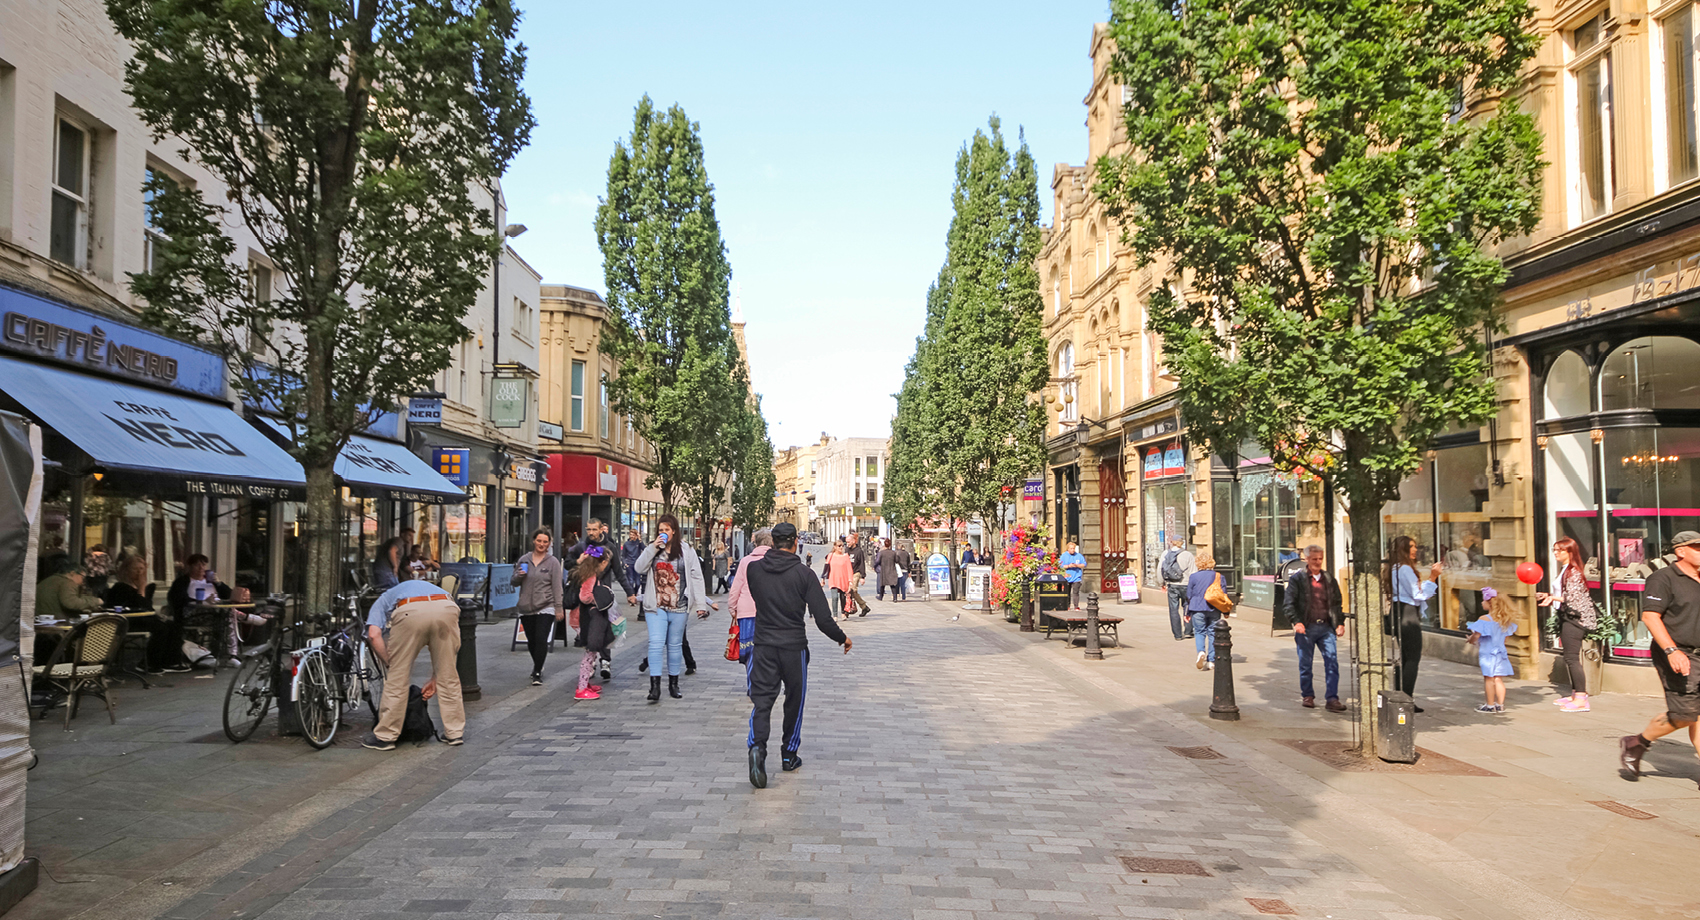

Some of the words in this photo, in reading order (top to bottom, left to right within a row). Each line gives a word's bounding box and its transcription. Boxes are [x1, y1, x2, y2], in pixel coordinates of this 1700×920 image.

[107, 340, 178, 381] NERO
[495, 393, 521, 401] COCK
[409, 410, 440, 419] NERO
[100, 411, 247, 457] NERO
[340, 450, 412, 475] NERO
[186, 481, 207, 493] THE
[210, 482, 244, 496] ITALIAN
[390, 490, 401, 499] THE
